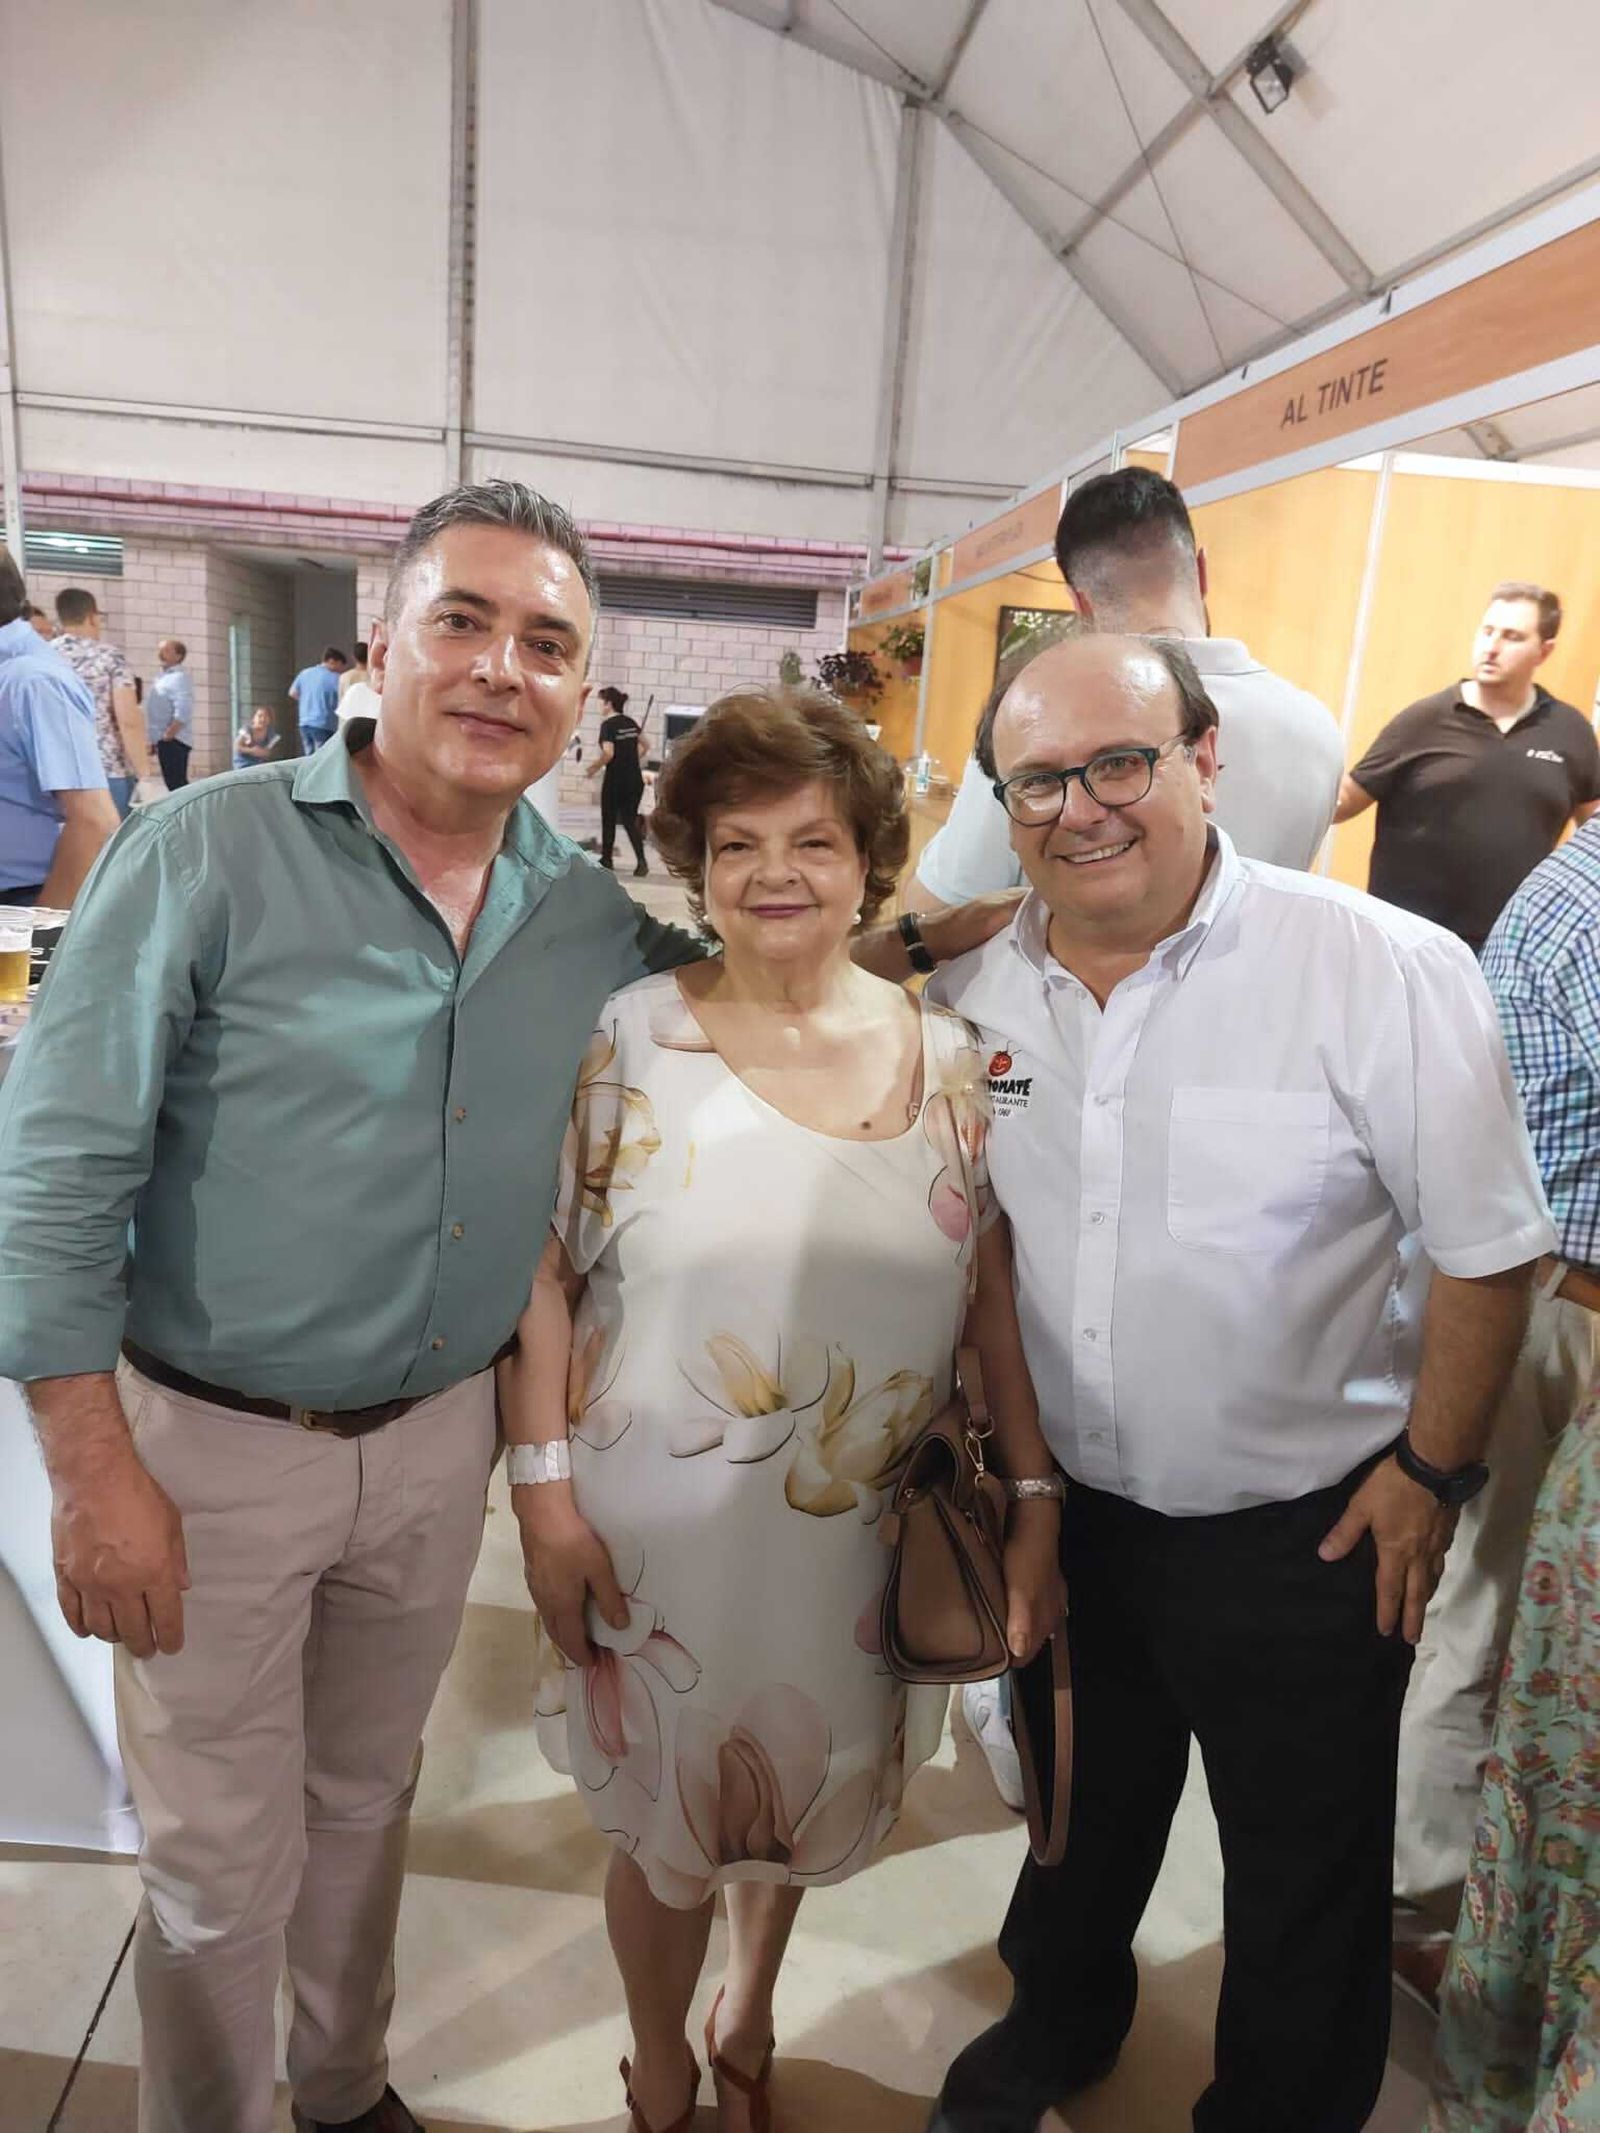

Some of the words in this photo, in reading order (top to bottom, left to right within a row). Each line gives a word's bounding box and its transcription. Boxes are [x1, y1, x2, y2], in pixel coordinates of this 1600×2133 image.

[1280, 392, 1308, 429] AL
[1318, 358, 1388, 415] TINTE
[987, 1077, 1033, 1096] TOMATE
